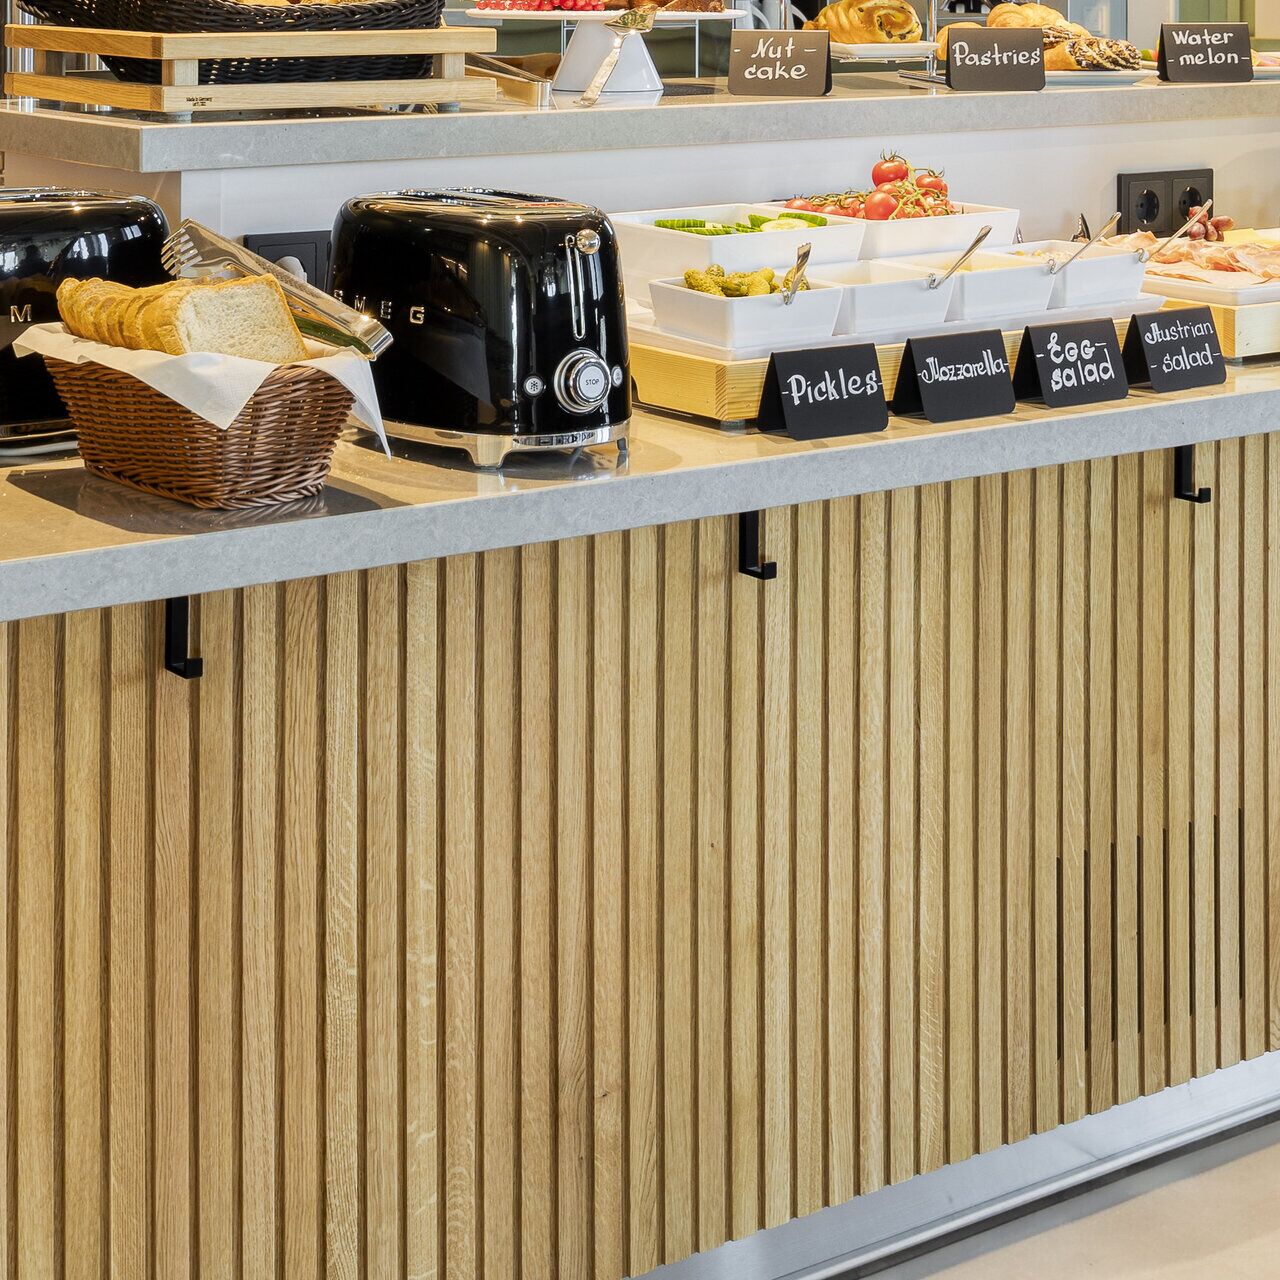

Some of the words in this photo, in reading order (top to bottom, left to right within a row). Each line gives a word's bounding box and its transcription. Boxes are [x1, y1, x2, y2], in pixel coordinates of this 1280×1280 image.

[750, 37, 795, 59] Nut
[1172, 28, 1234, 46] Water
[951, 41, 1041, 67] Pastries
[1179, 48, 1239, 66] melon
[743, 61, 808, 80] cake
[1144, 320, 1214, 345] Austrian
[921, 349, 1007, 384] Mozzarella
[1050, 348, 1115, 392] salad
[1162, 343, 1214, 373] salad
[585, 378, 600, 386] STOP
[787, 368, 879, 406] Pickles
